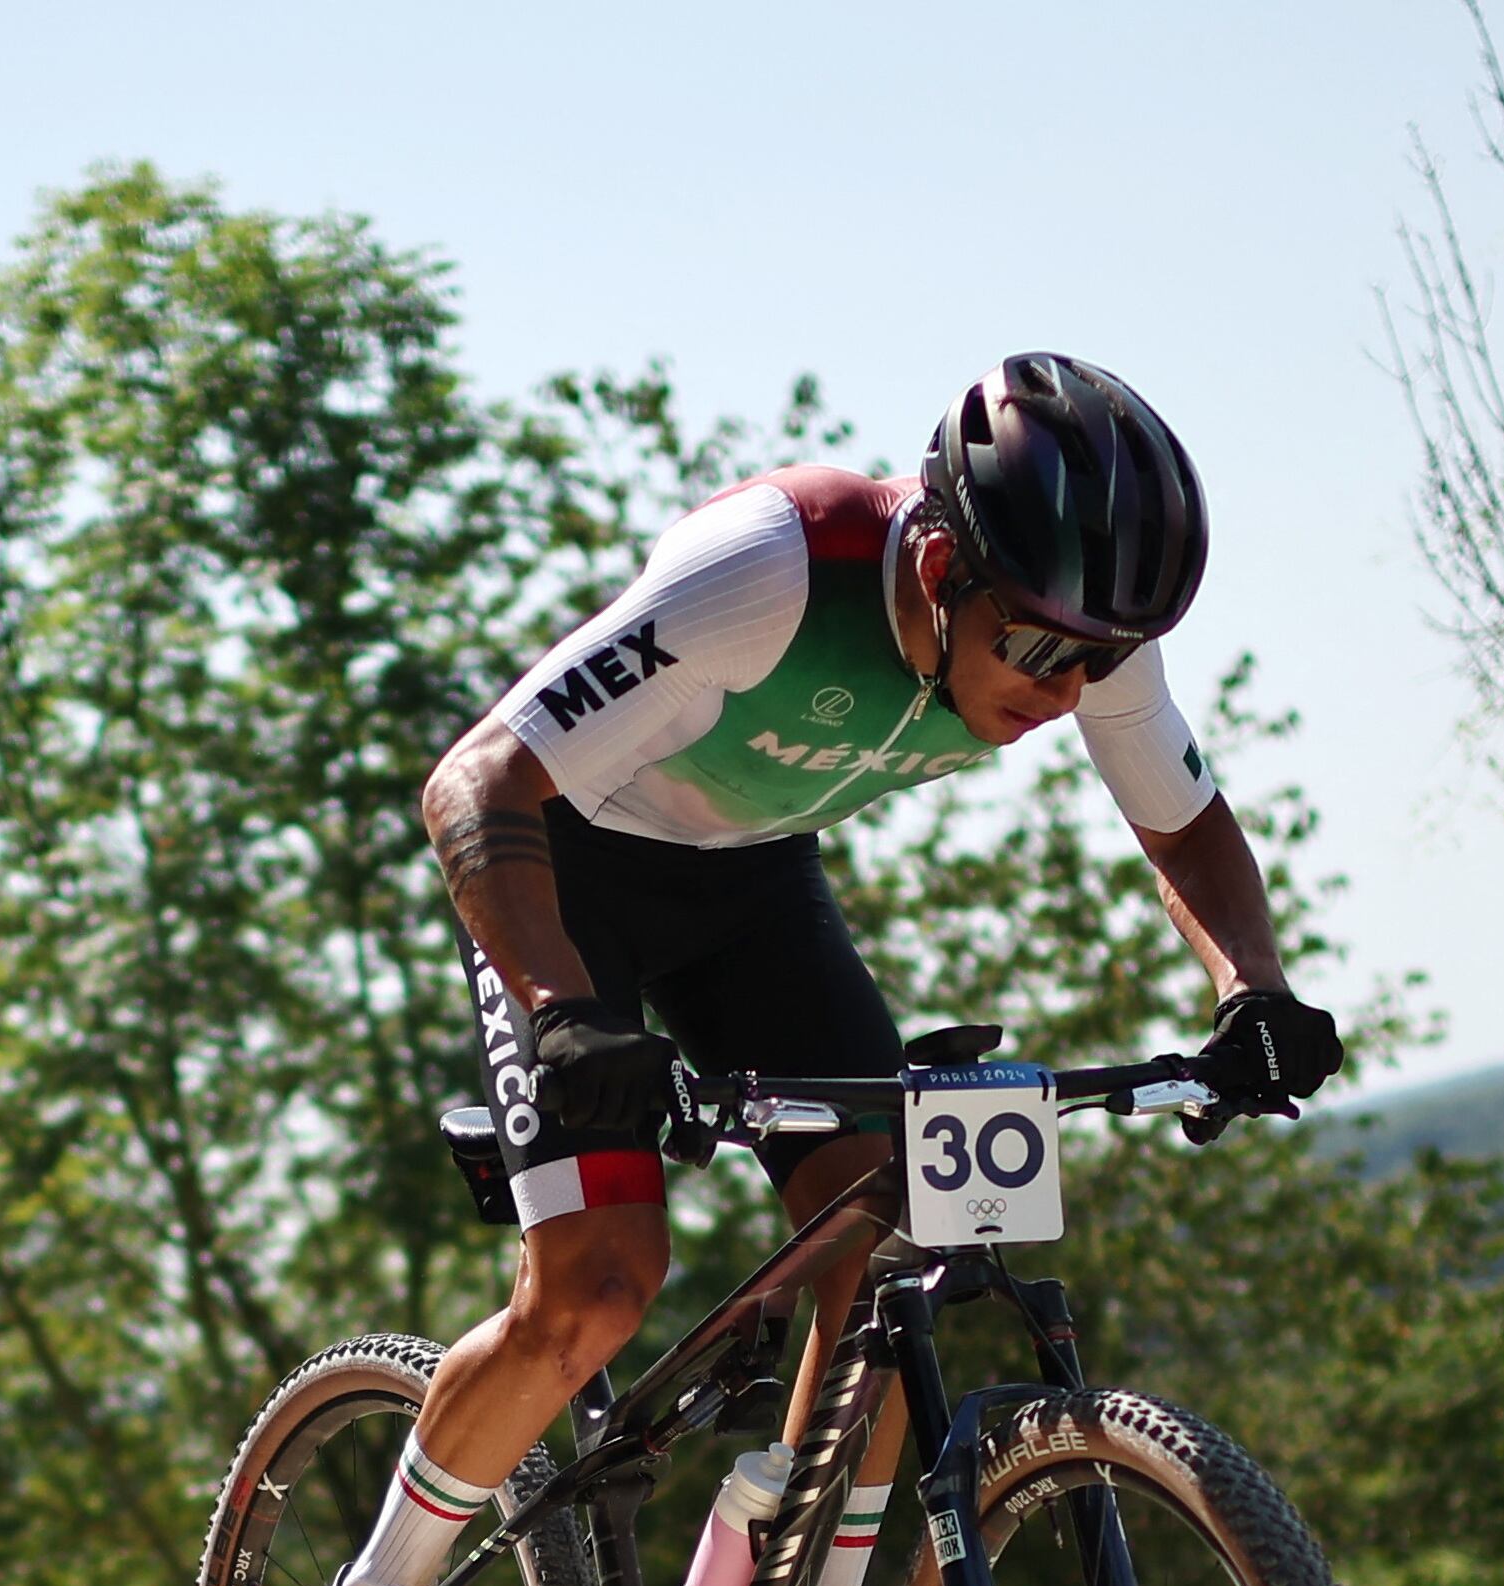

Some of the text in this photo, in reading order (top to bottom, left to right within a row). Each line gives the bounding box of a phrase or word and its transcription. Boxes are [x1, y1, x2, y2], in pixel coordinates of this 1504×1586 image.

[956, 474, 989, 559] CANYON
[536, 619, 679, 732] MEX
[929, 1069, 1026, 1083] PARIS 2024
[1257, 1021, 1280, 1081] ERGON
[671, 1060, 694, 1122] ERGON
[921, 1112, 1045, 1191] 30
[1004, 1476, 1059, 1514] XRC 1200
[233, 1548, 252, 1581] XRC
